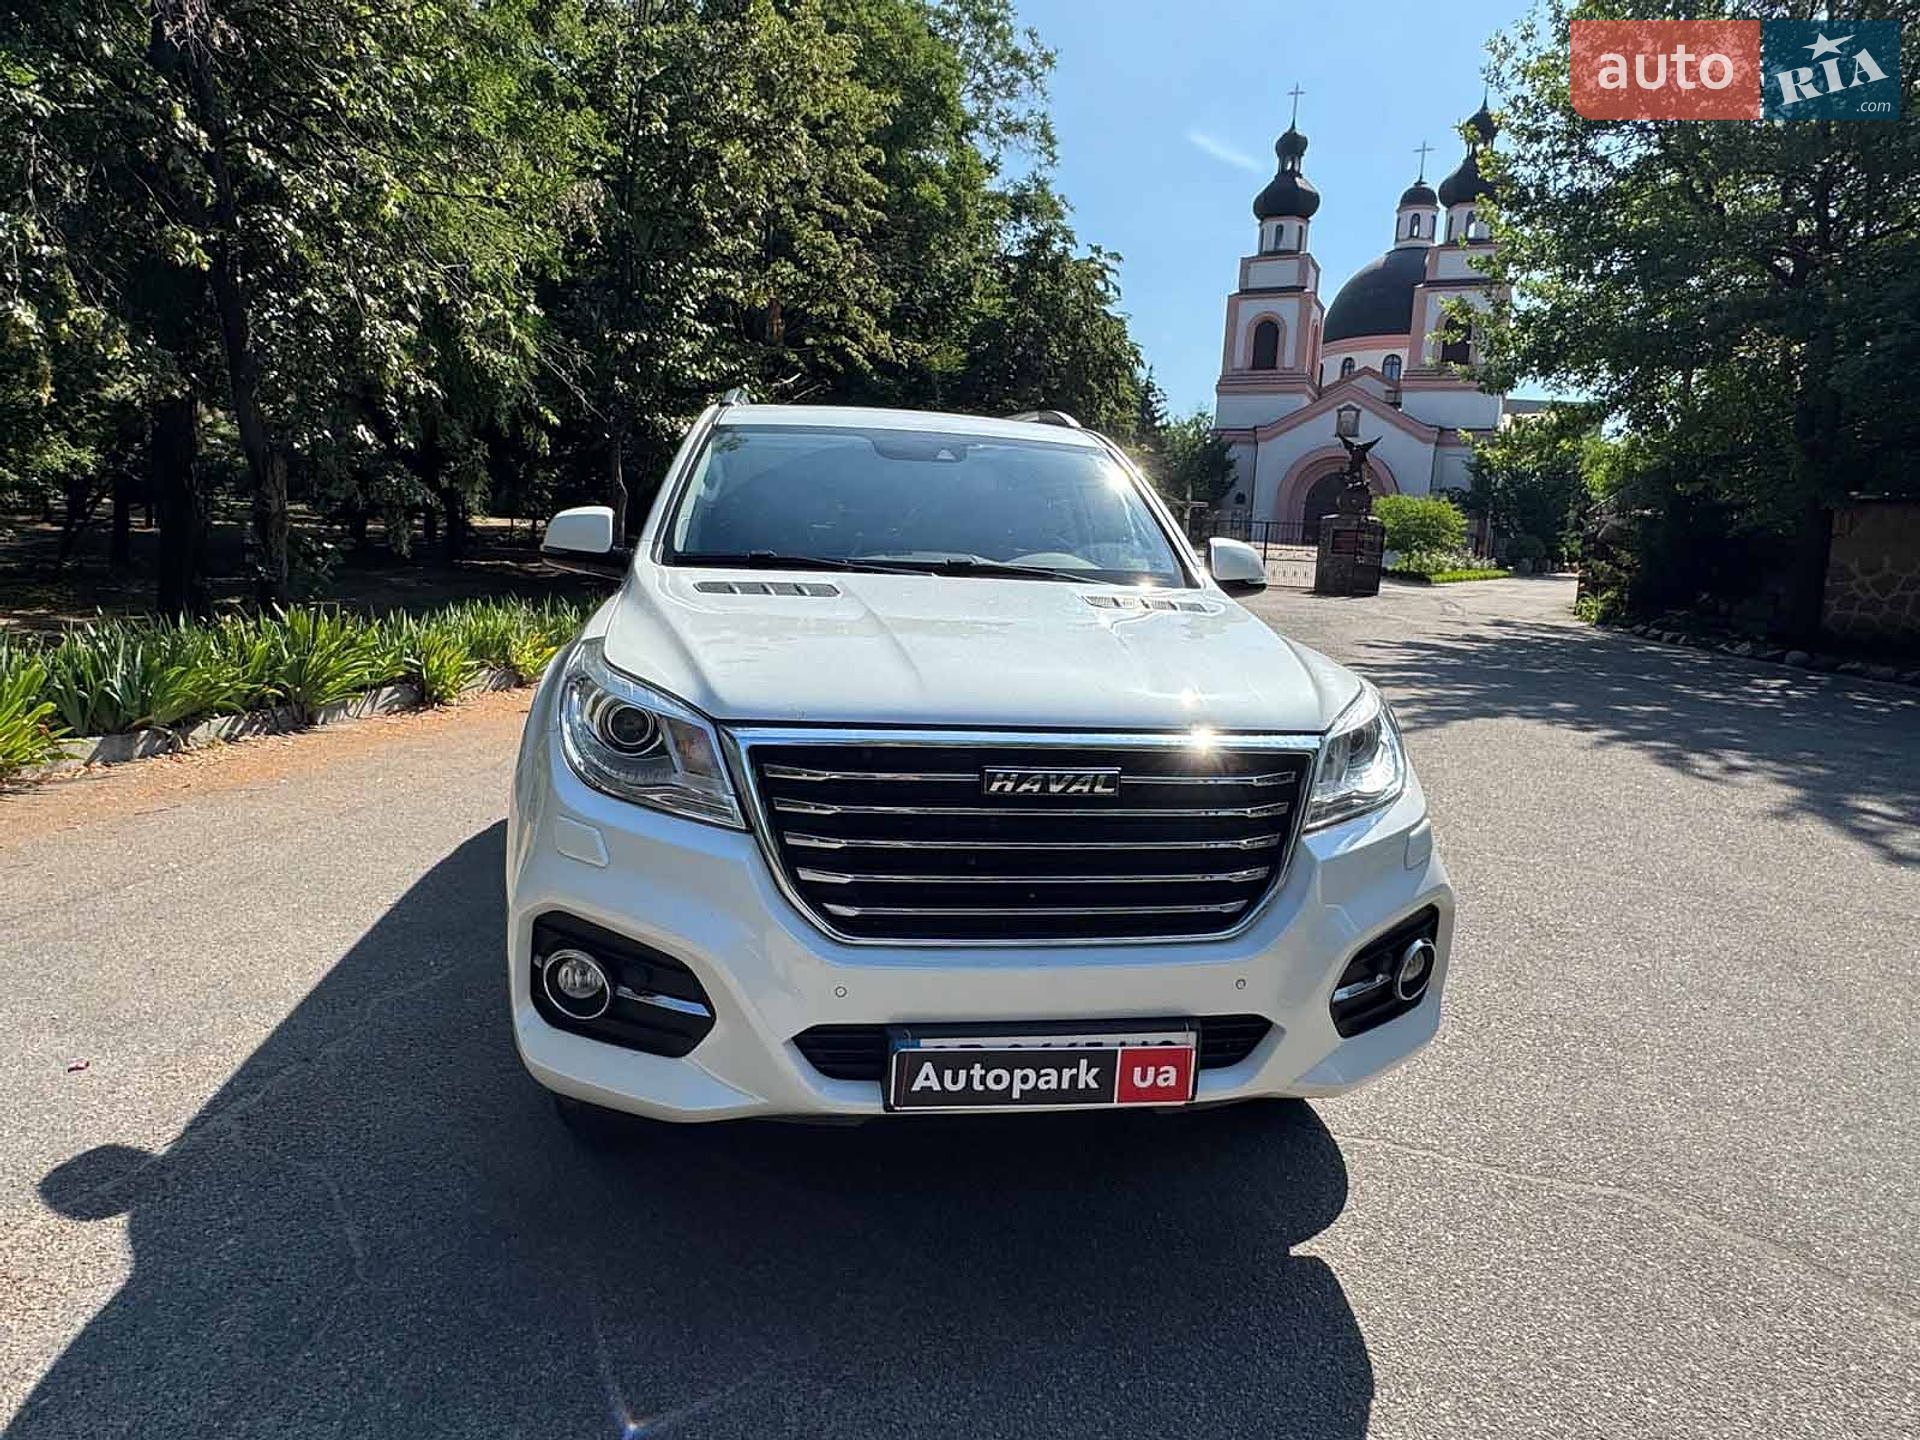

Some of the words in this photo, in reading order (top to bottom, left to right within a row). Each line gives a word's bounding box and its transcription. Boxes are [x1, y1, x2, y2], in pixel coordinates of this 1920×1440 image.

[989, 773, 1115, 793] HAVAL
[911, 1058, 1100, 1099] Autopark
[1132, 1065, 1177, 1088] ua
